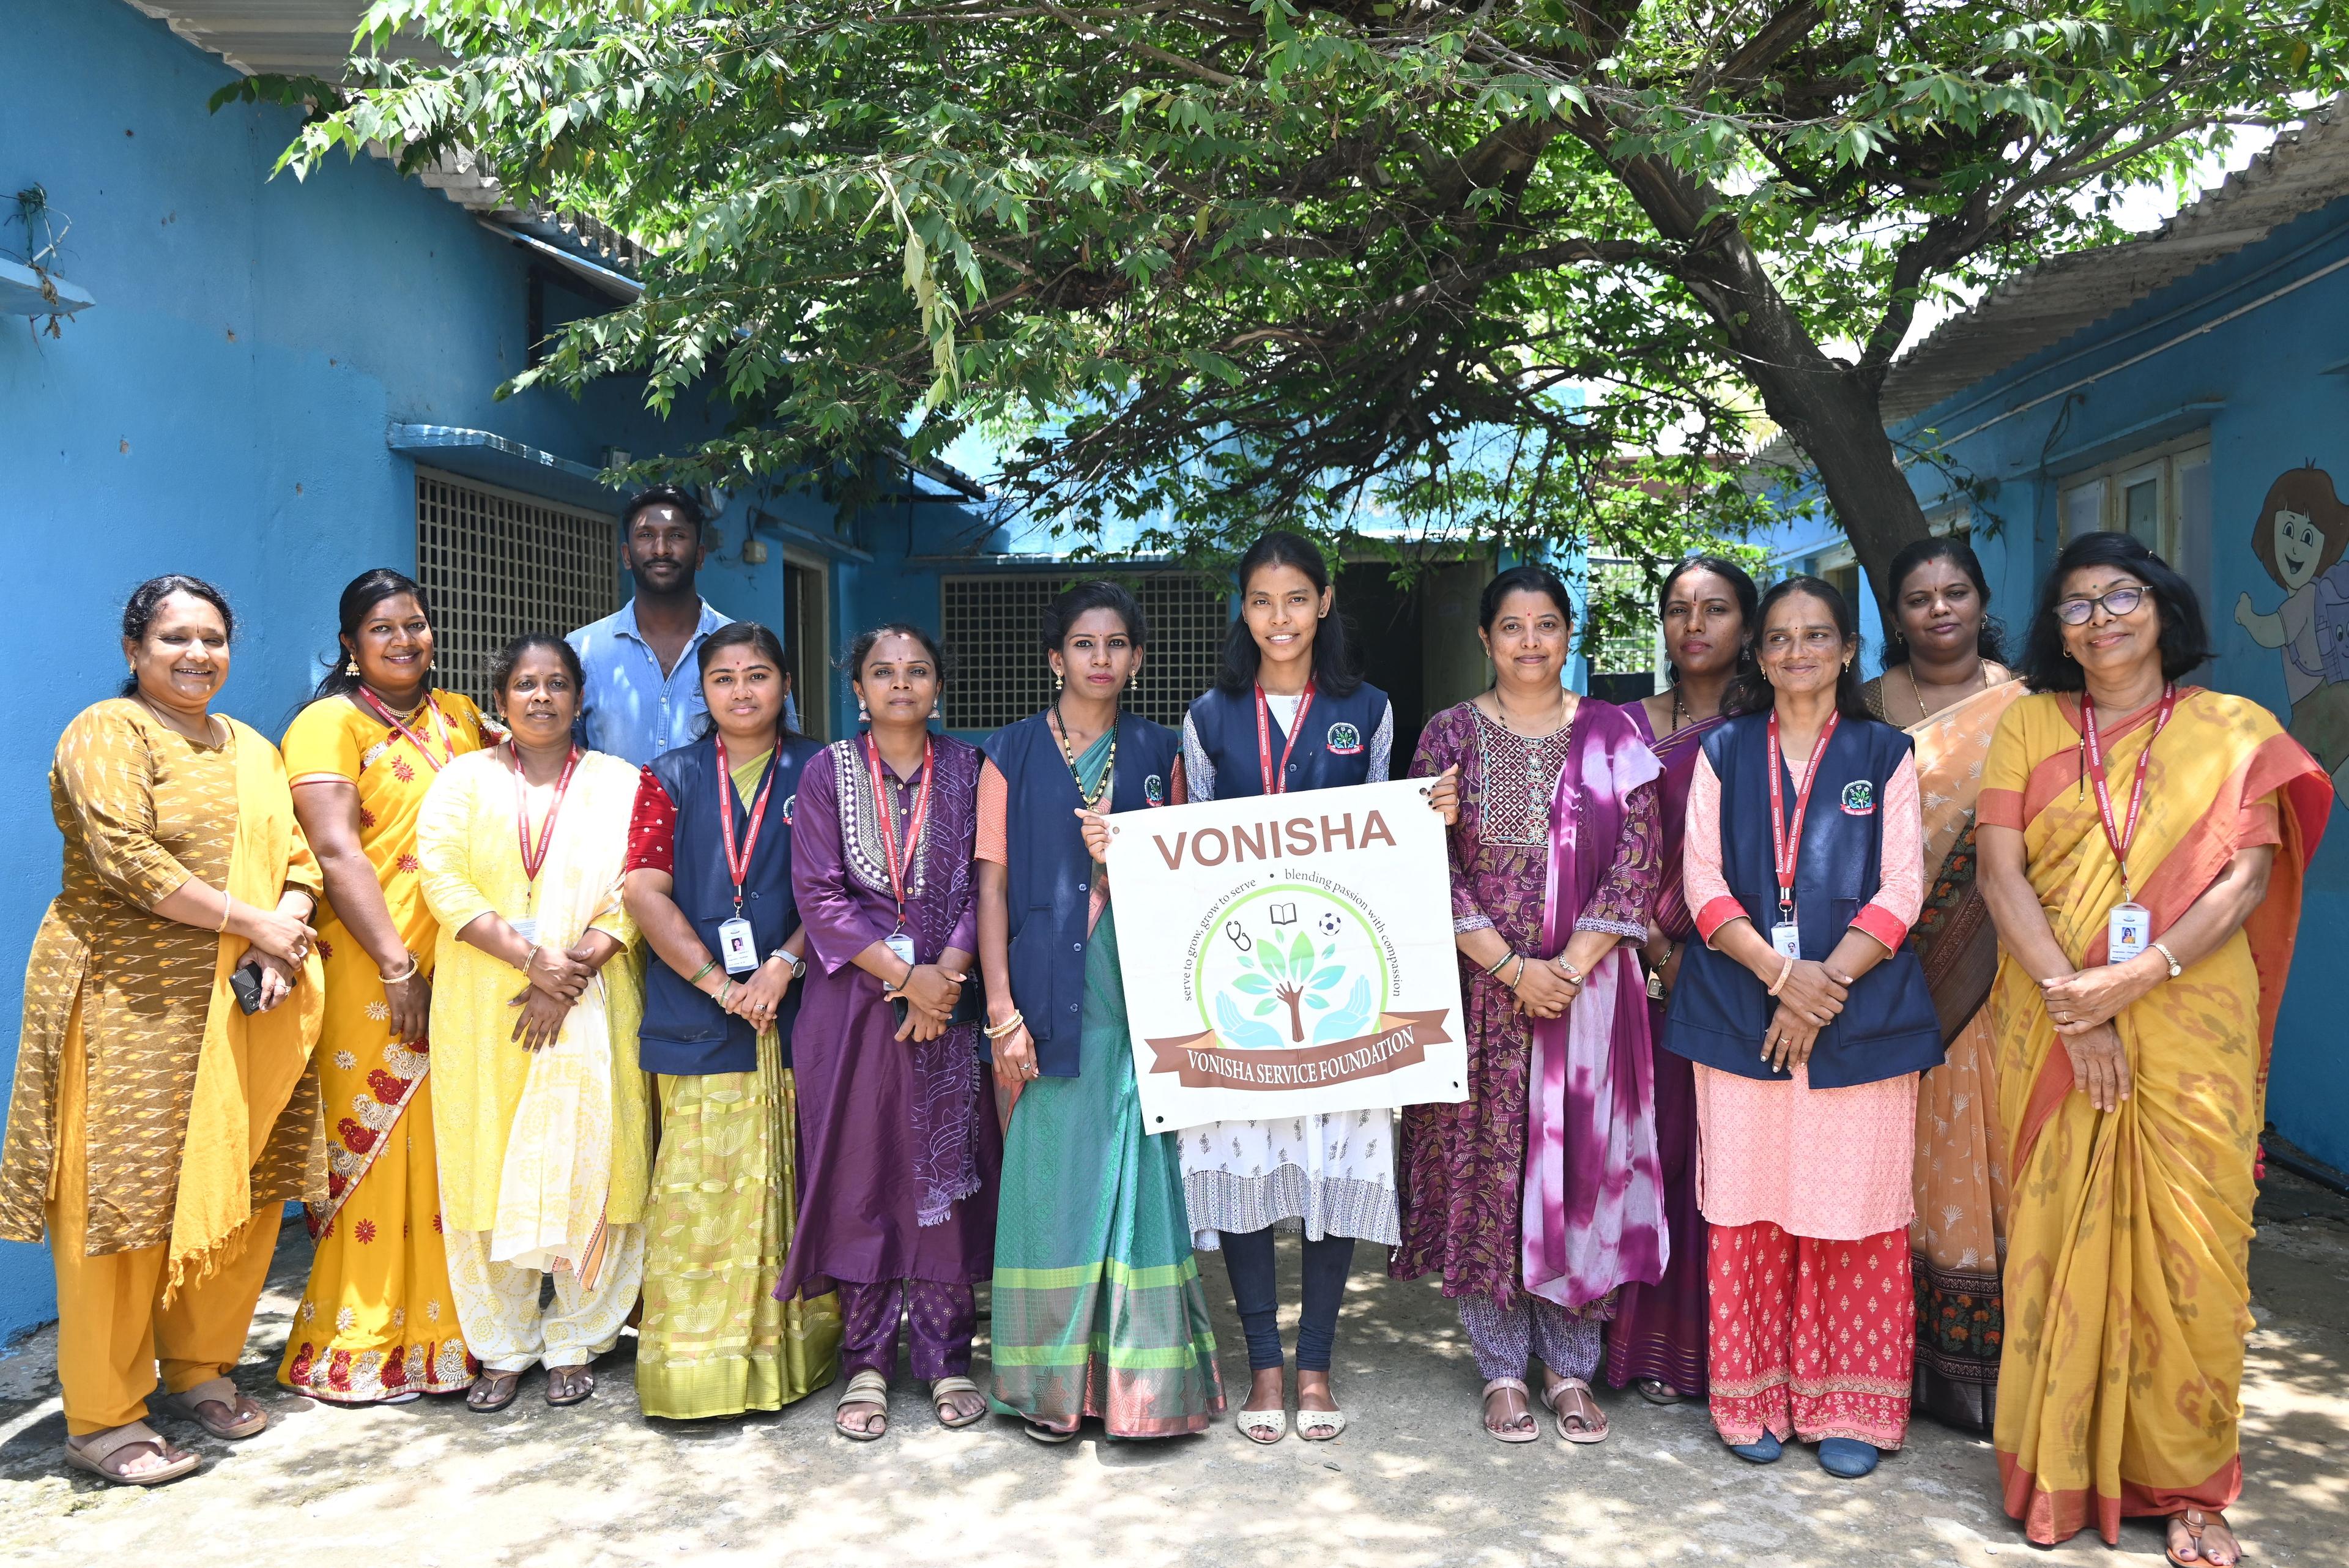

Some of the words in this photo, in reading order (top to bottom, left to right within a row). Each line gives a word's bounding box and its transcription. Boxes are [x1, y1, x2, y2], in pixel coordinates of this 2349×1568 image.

[1152, 809, 1397, 870] VONISHA
[1219, 895, 1230, 905] to
[1230, 879, 1256, 897] serve
[1200, 903, 1220, 930] grow
[1188, 929, 1204, 958] grow,
[1285, 868, 1332, 890] blending
[1332, 882, 1368, 910] passion
[1368, 909, 1386, 933] with
[1381, 935, 1403, 997] compassion
[1184, 959, 1192, 970] to
[1184, 972, 1192, 1001] serve
[1186, 1049, 1255, 1082] VONISHA
[1256, 1062, 1318, 1084] SERVICE
[1318, 1025, 1415, 1081] FOUNDATION
